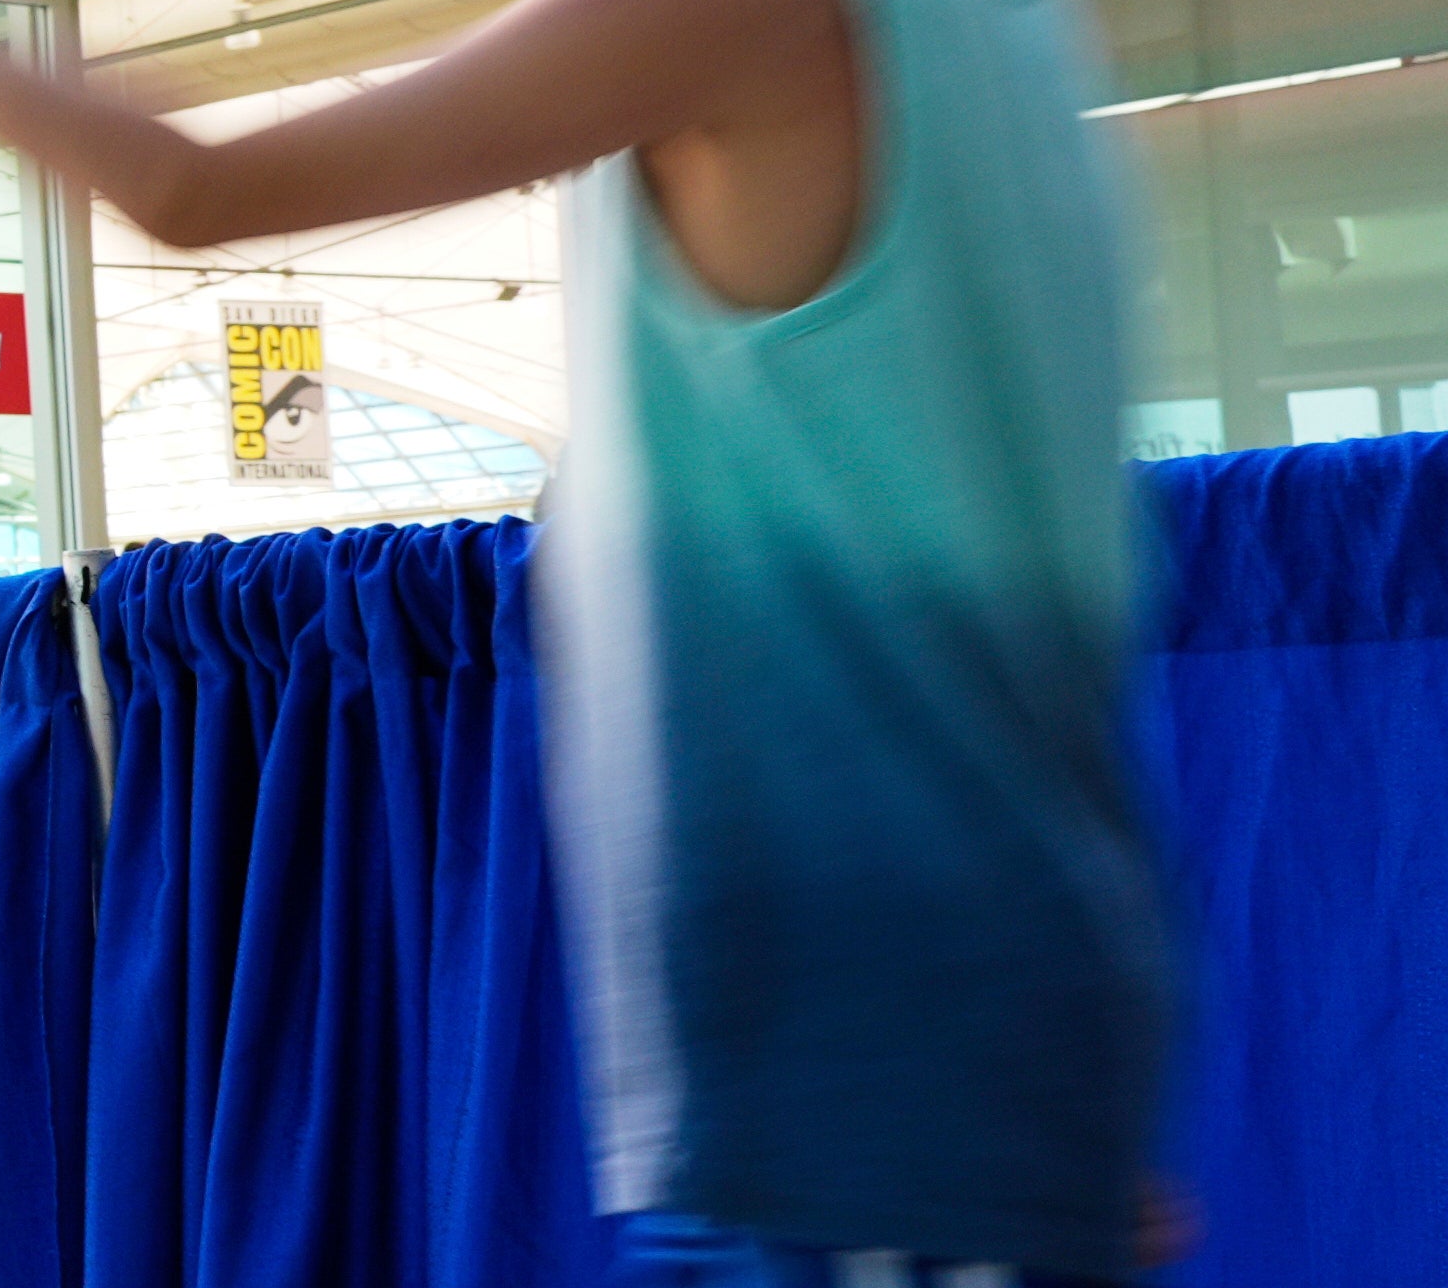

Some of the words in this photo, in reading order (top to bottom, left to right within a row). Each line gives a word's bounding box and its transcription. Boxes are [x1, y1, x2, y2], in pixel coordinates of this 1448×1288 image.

[259, 325, 324, 372] CON
[226, 324, 268, 460] COMIC
[235, 463, 329, 480] INTERNATIONAL
